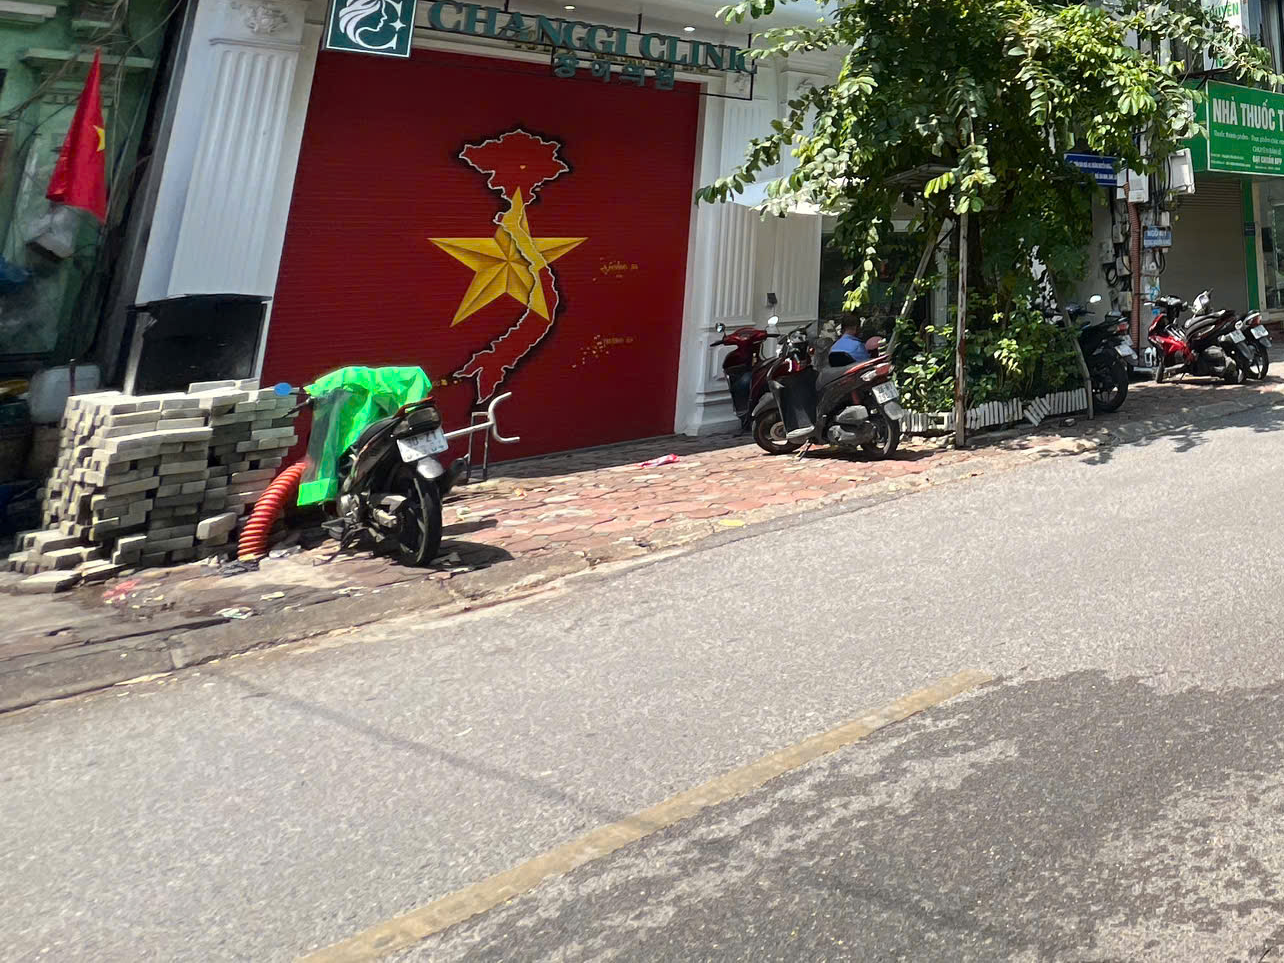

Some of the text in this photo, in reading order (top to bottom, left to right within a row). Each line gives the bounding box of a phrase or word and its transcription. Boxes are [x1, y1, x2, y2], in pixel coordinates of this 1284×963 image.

[427, 0, 758, 75] CHANGGI CLINIC
[1212, 96, 1238, 126] NHÀ
[1240, 99, 1276, 131] THUỐC
